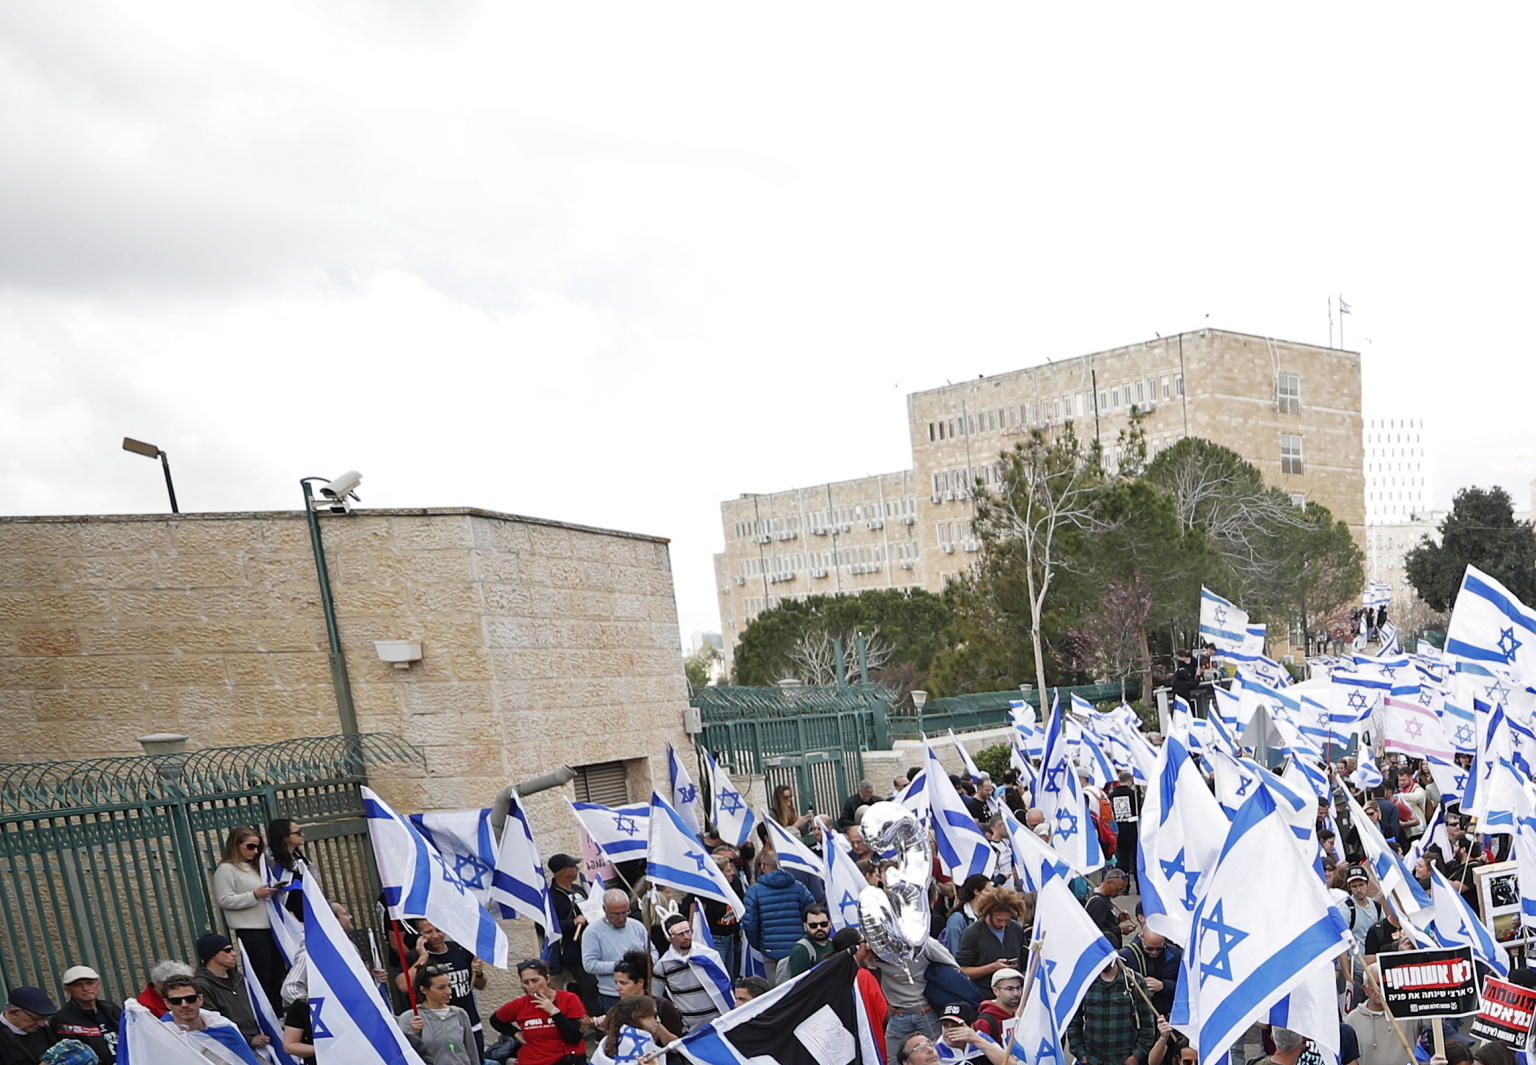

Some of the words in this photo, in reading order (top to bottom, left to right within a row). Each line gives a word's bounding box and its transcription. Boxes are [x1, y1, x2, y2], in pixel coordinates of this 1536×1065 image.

[1451, 960, 1472, 983] לא
[1388, 993, 1406, 1002] פניה
[1408, 992, 1420, 1000] את
[1422, 990, 1446, 998] שינתה
[1448, 989, 1466, 998] ארצי
